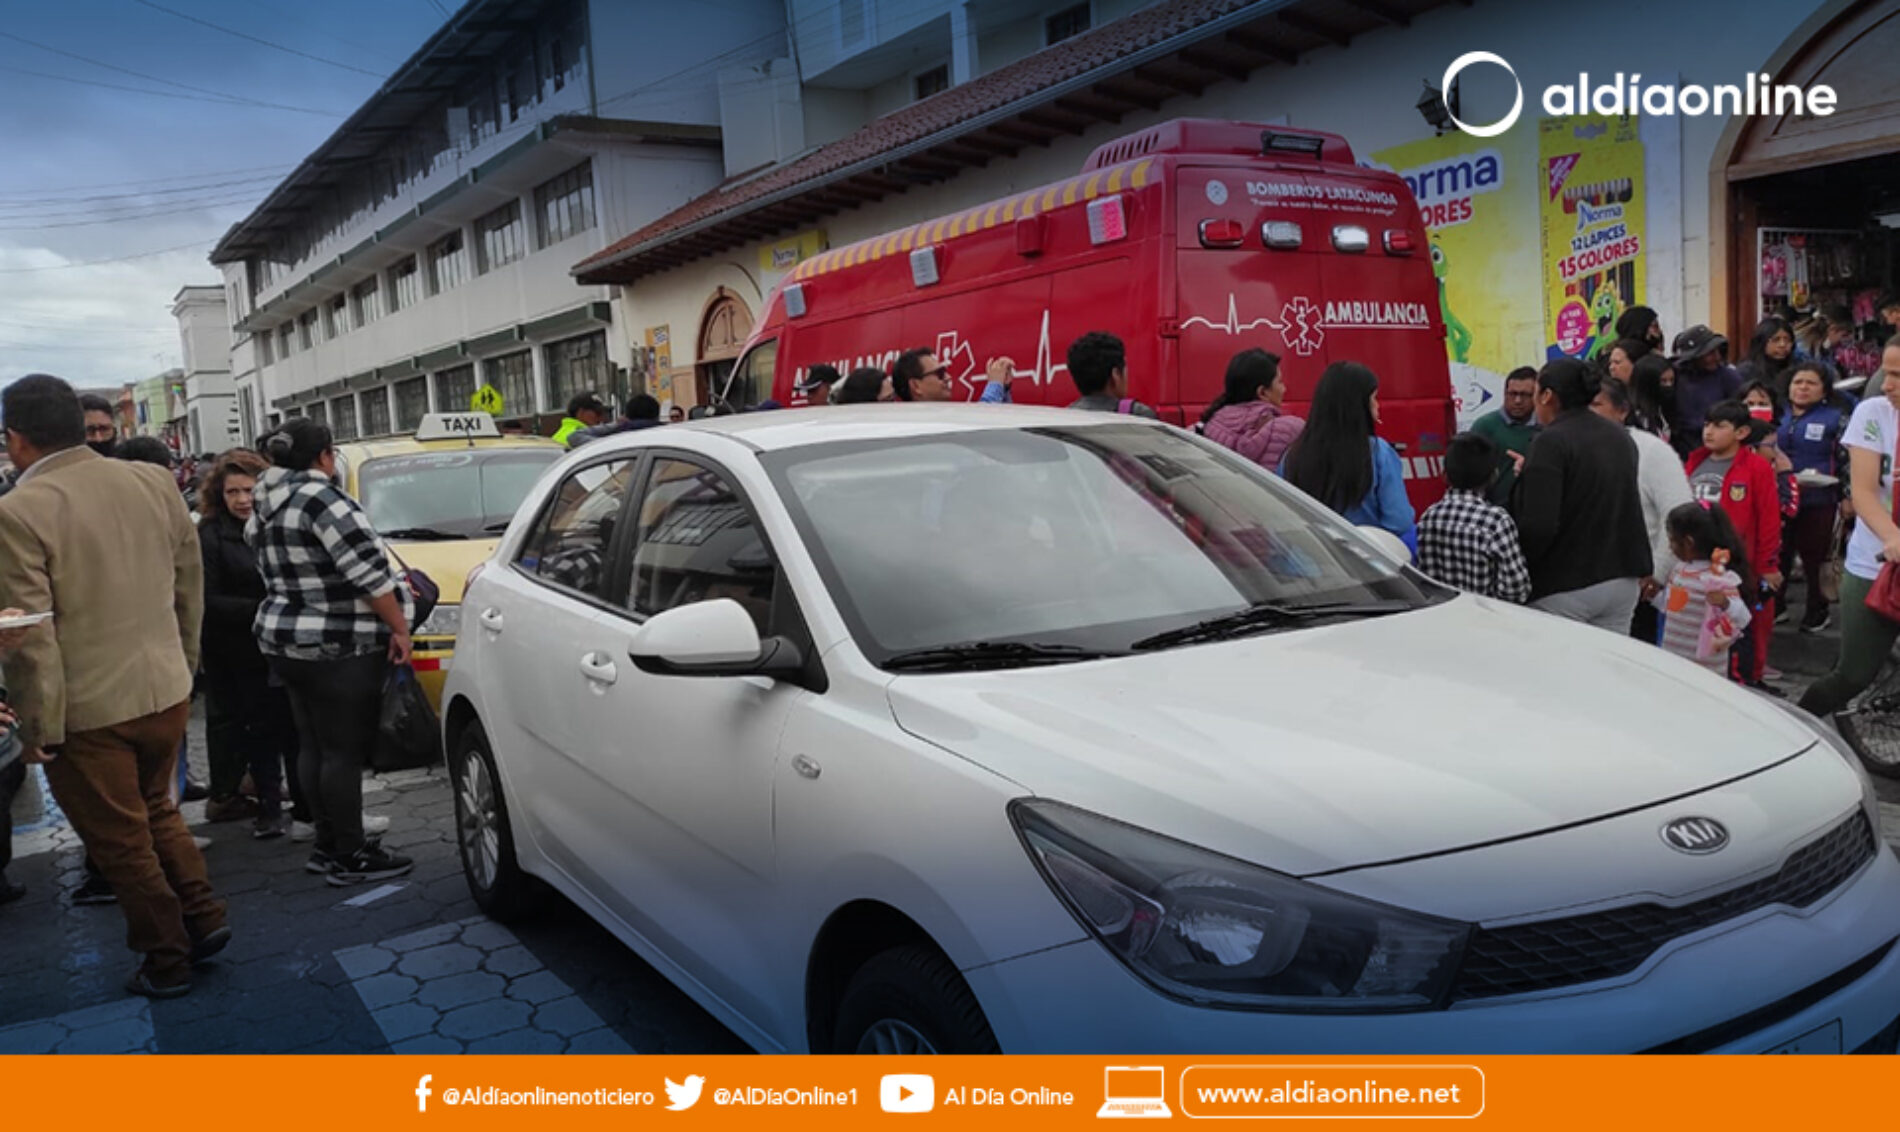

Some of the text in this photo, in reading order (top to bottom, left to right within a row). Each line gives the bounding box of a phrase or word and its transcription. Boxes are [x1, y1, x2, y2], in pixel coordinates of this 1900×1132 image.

[1246, 181, 1398, 206] BOMBEROS LATACUNGA
[1571, 236, 1583, 251] 12
[1557, 236, 1640, 279] 15 COLORES
[1324, 301, 1430, 325] AMBULANCIA
[441, 416, 482, 432] TAXI
